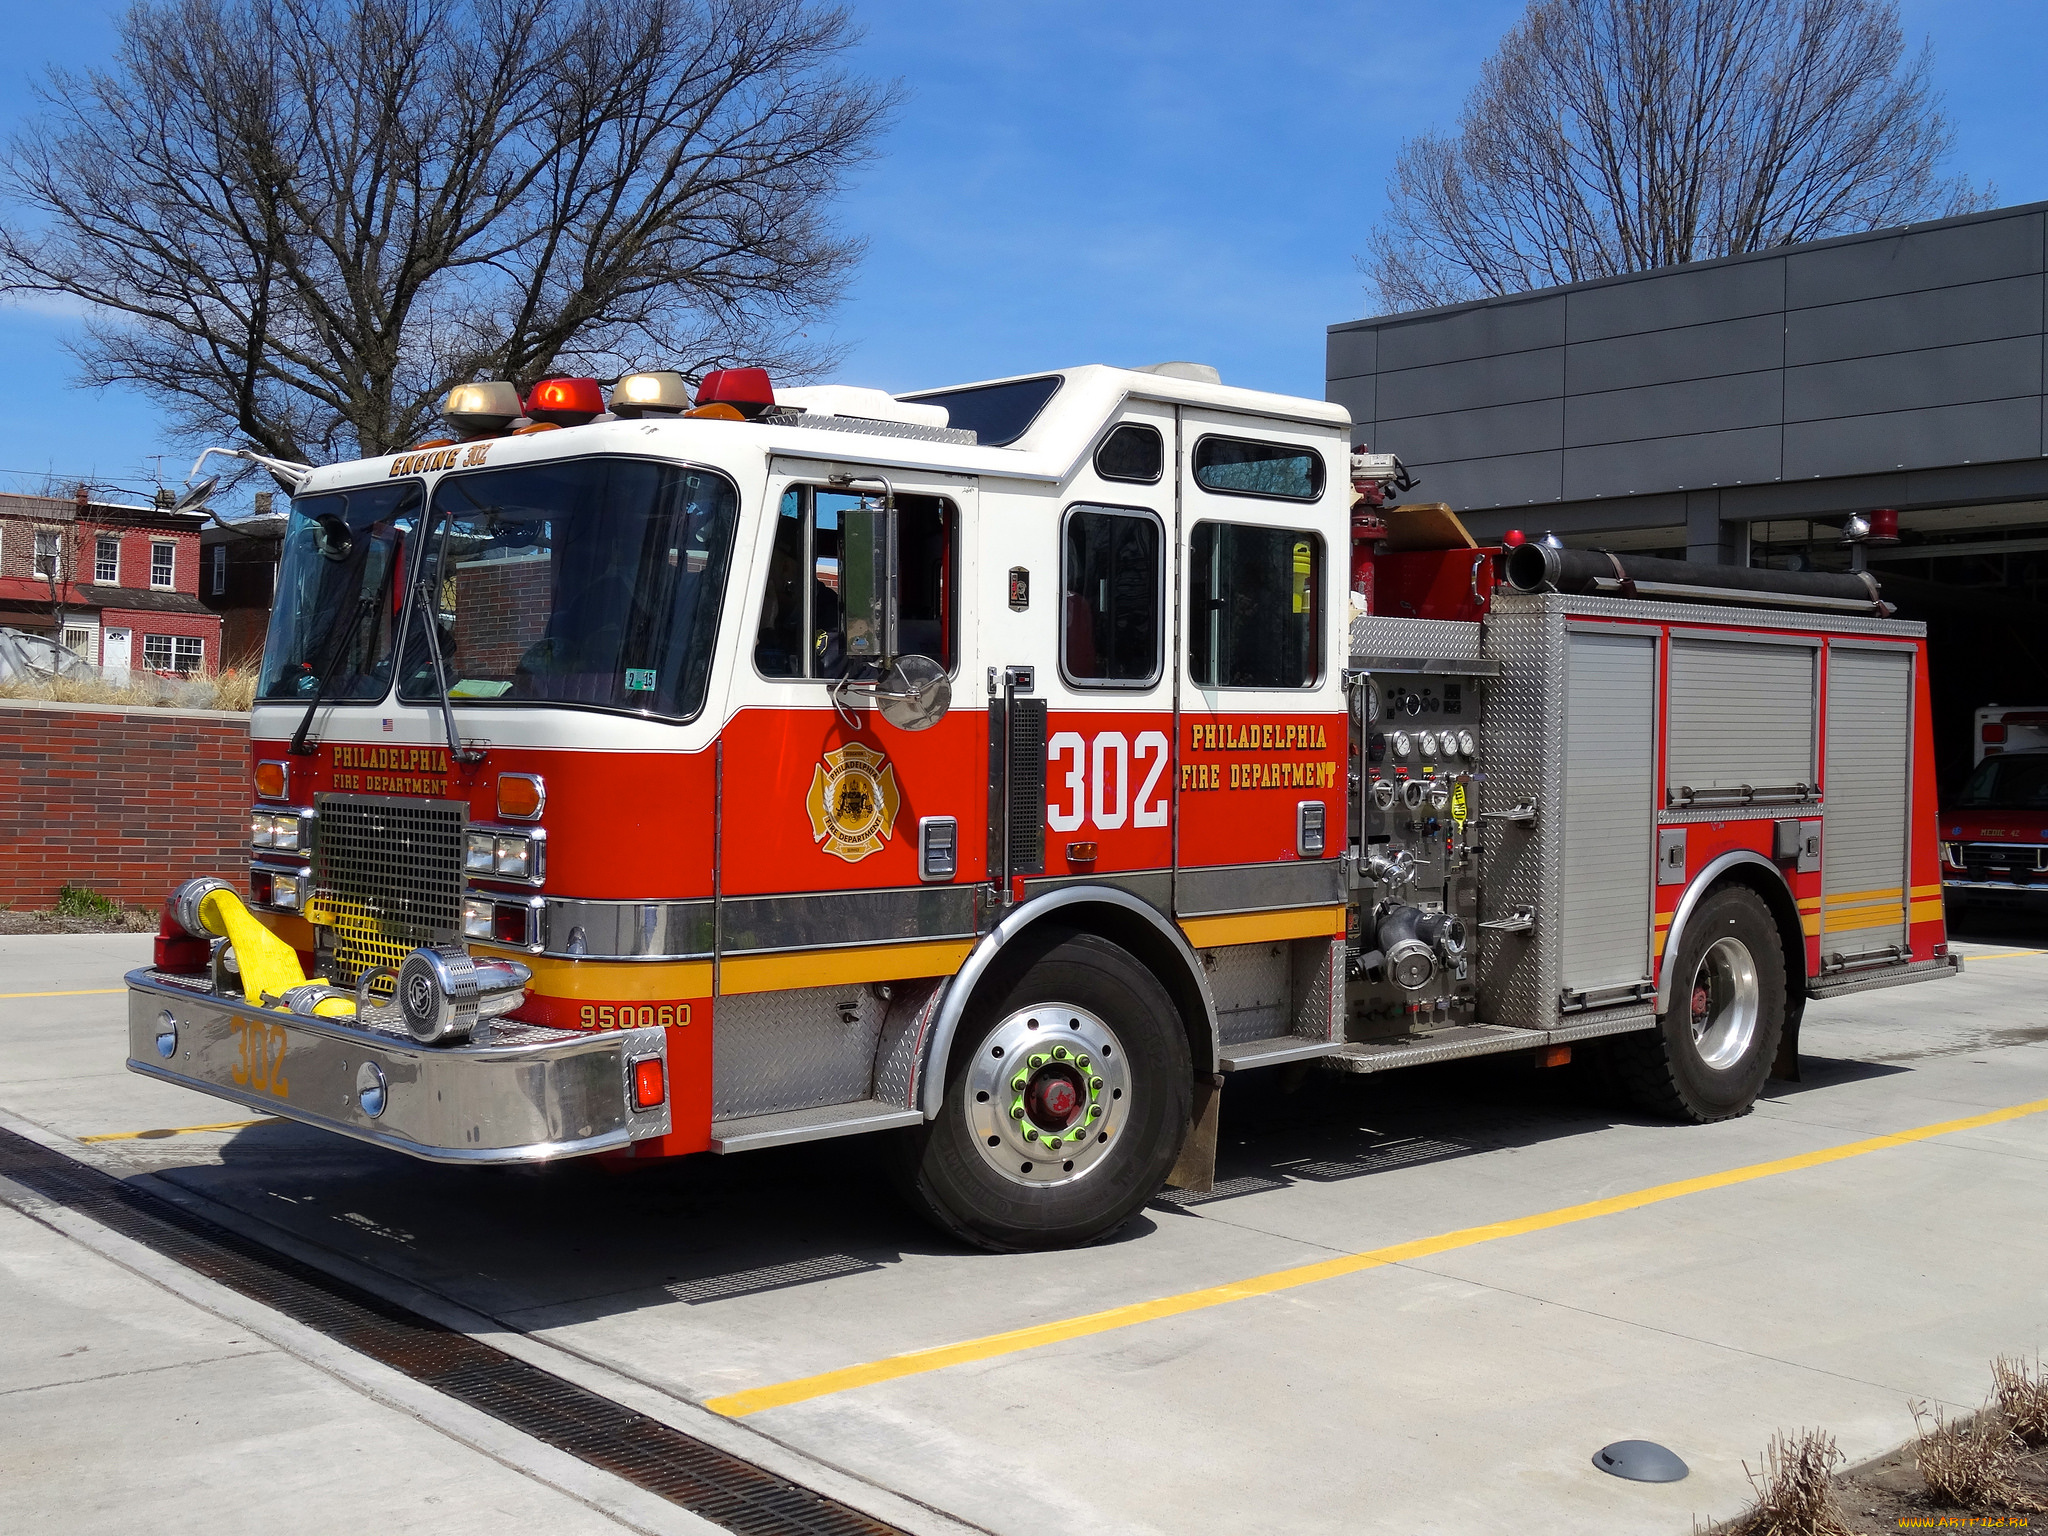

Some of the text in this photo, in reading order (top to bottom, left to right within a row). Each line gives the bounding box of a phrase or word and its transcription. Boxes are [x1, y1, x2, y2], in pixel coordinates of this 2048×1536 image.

[389, 443, 493, 477] ENGINE 302
[1192, 724, 1327, 750] PHILADELPHIA
[333, 746, 448, 772] PHILADELPHIA
[830, 761, 878, 780] PHILADELPHIA
[333, 774, 448, 795] FIRE DEPARTMENT
[1047, 731, 1169, 832] 302
[1181, 762, 1336, 791] FIRE DEPARTMENT
[825, 817, 882, 843] FIRE DEPARTMENT
[1980, 829, 2005, 837] MEDIC
[580, 1003, 691, 1028] 950060
[230, 1015, 289, 1098] 302
